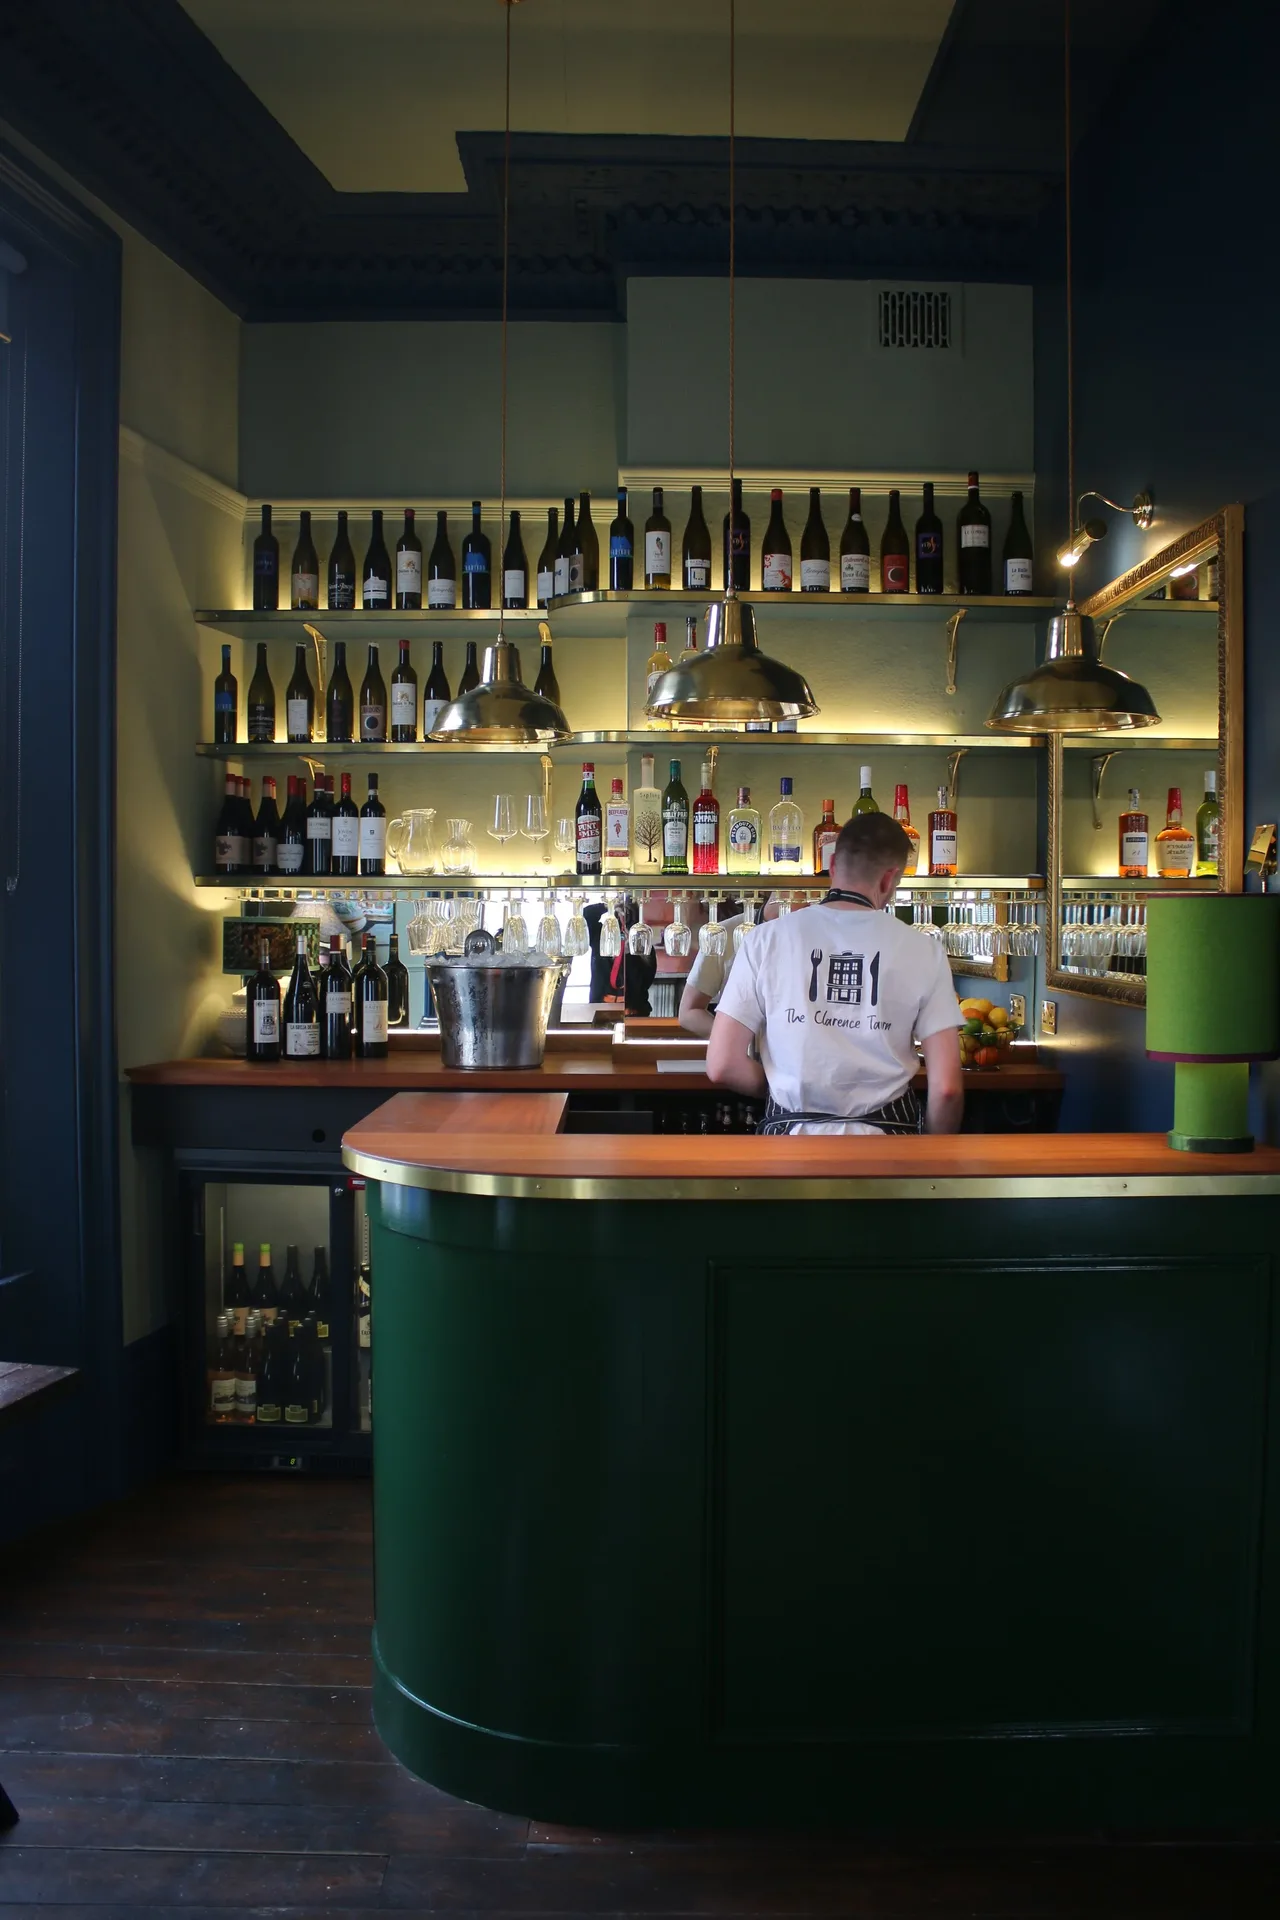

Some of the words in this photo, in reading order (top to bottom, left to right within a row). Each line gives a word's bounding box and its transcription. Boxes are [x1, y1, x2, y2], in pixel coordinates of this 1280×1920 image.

[578, 822, 597, 832] PUNT
[582, 829, 600, 838] MES
[731, 821, 752, 837] PLYMOUTH
[785, 1008, 806, 1023] The
[814, 1010, 861, 1029] Clarence
